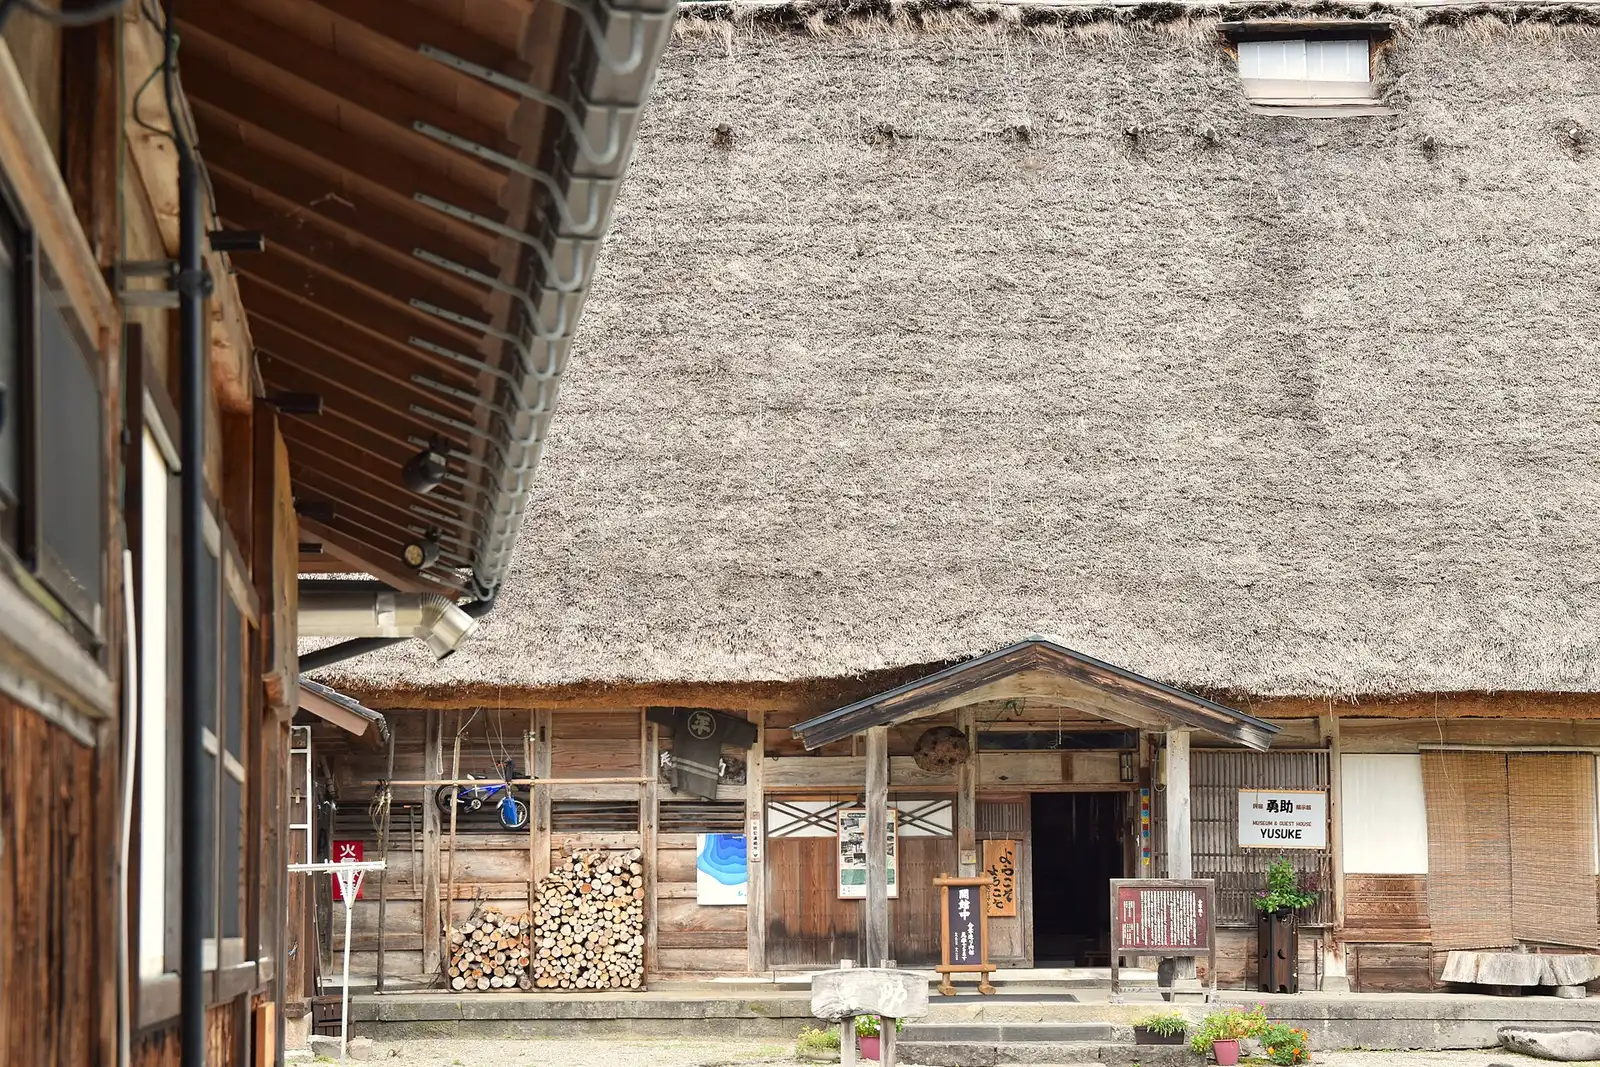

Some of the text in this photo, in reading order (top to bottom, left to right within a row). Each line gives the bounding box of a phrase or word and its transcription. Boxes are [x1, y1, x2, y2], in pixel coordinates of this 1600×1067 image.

[1266, 799, 1293, 814] 勇助
[1260, 828, 1302, 839] YUSUKE
[958, 888, 971, 921] 開館中
